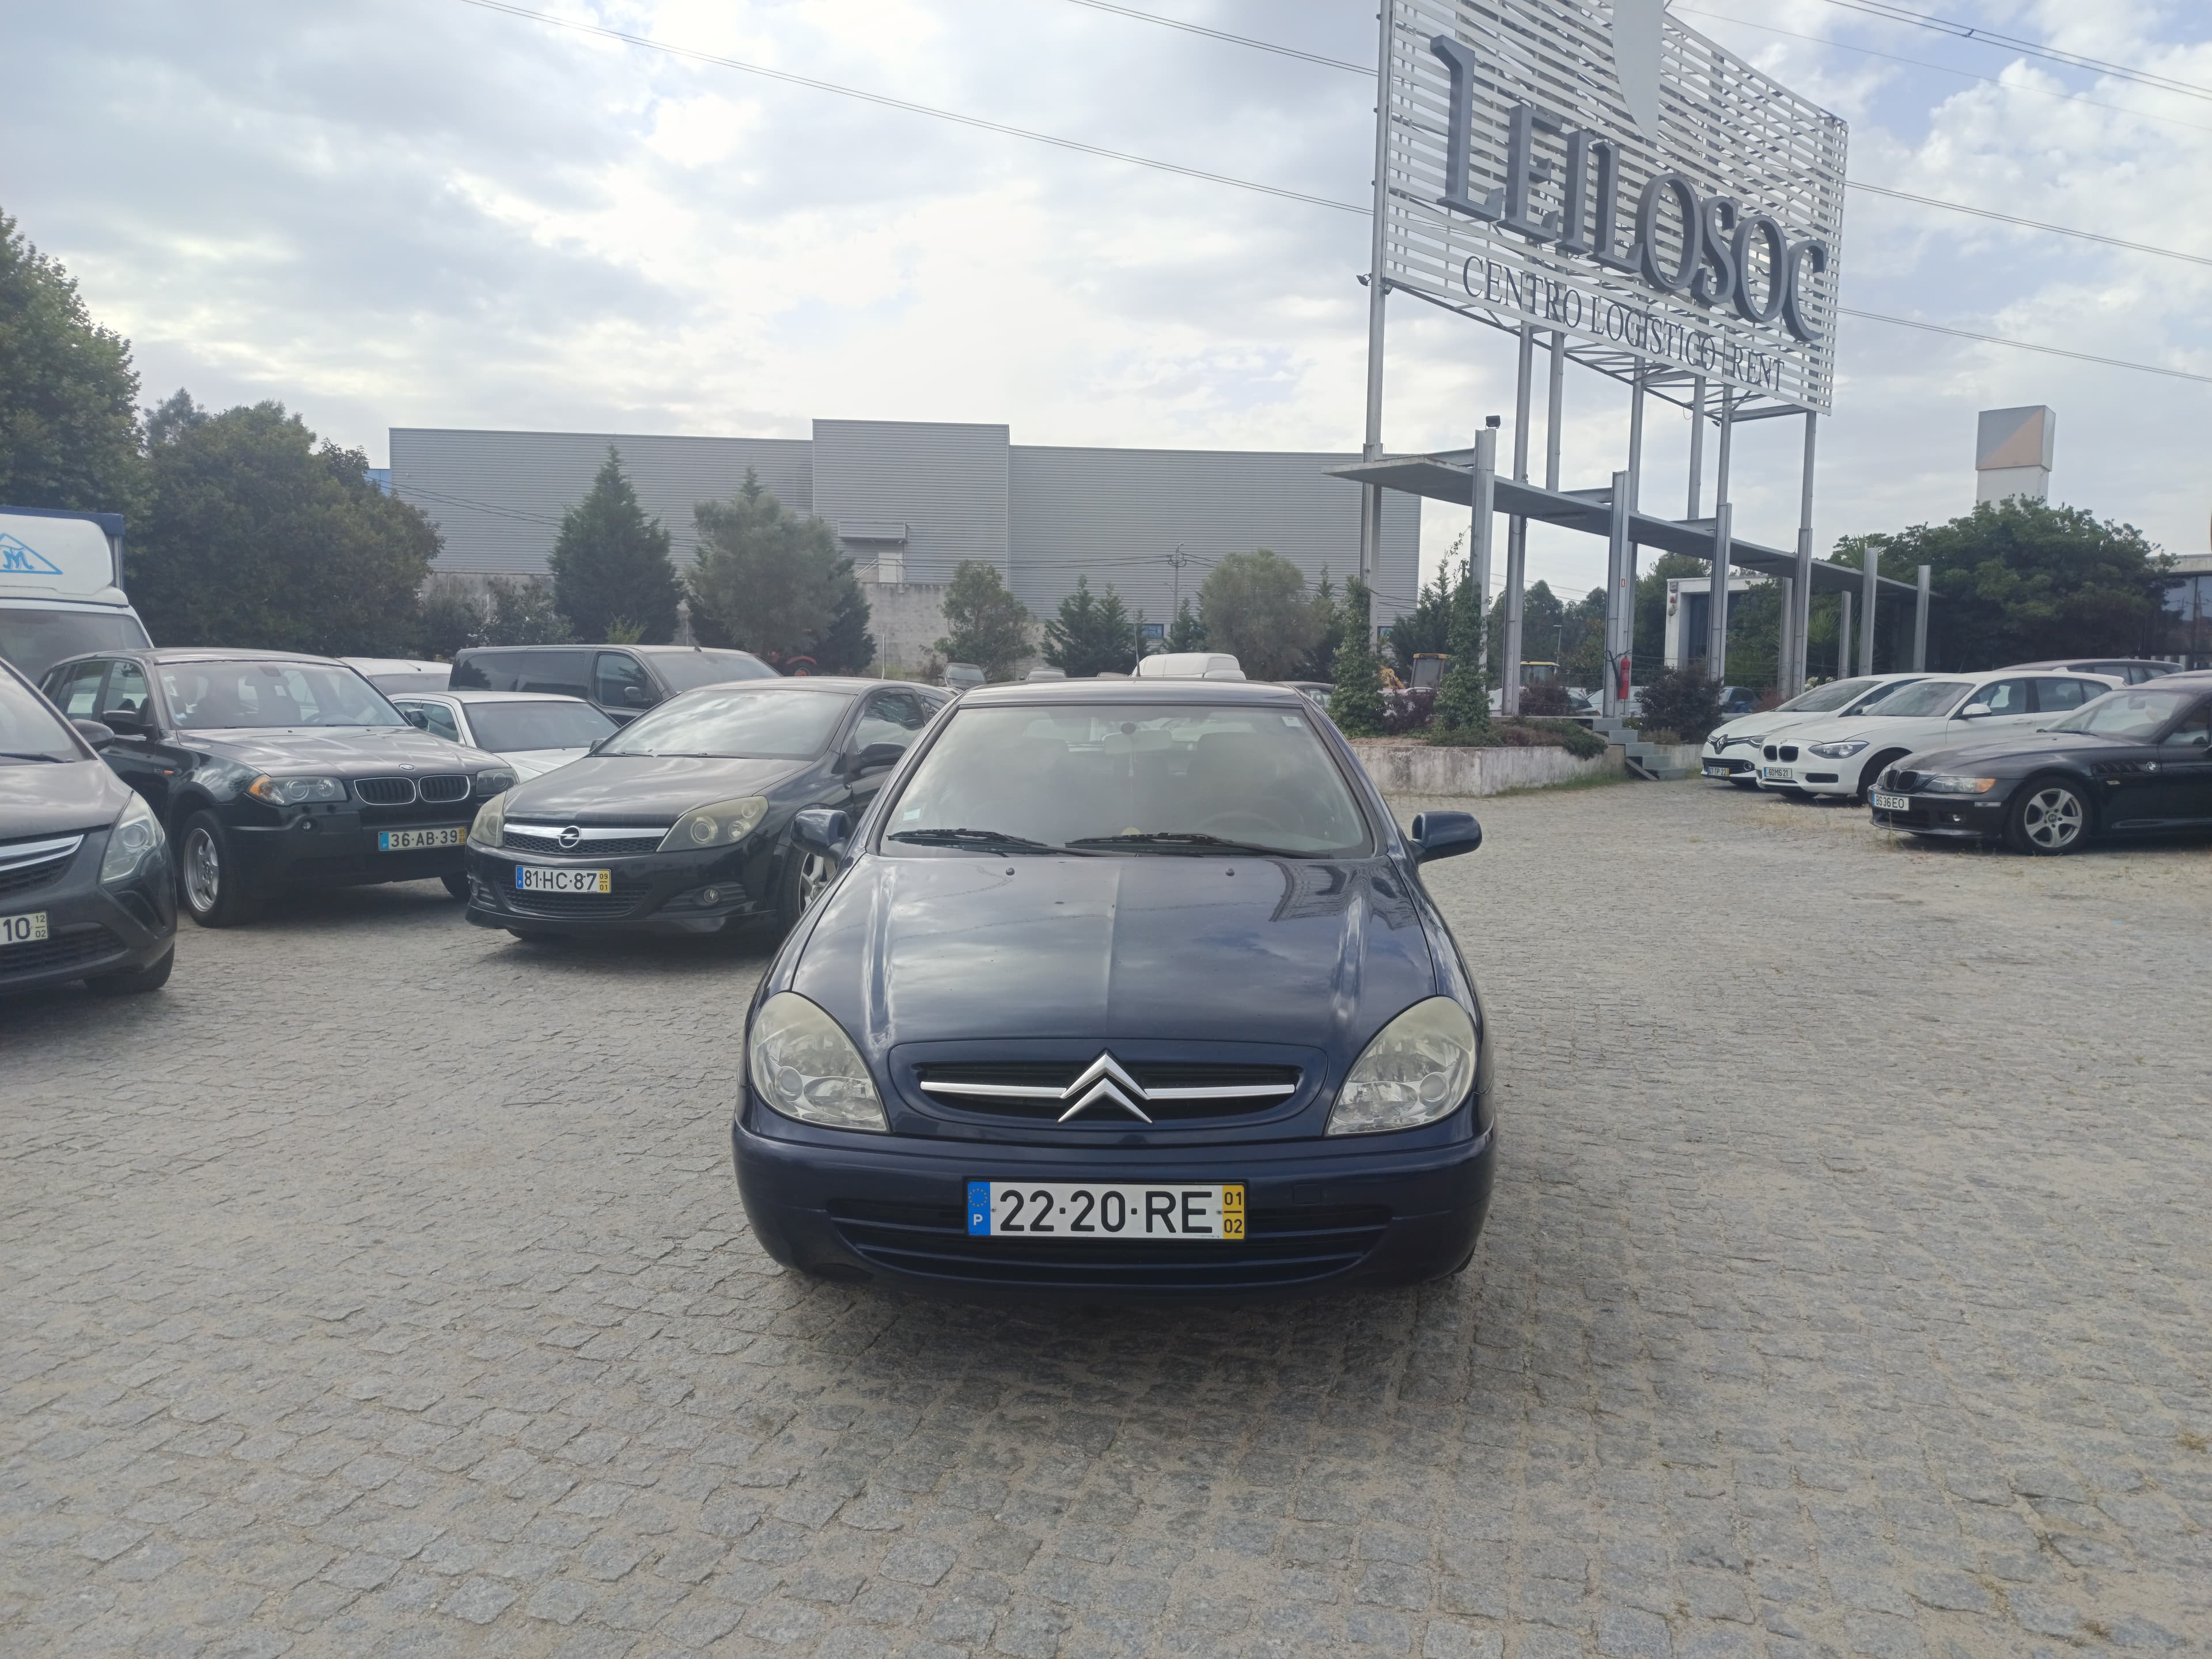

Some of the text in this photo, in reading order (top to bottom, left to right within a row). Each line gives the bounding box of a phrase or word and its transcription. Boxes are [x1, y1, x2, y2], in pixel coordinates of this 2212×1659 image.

[1430, 35, 1830, 341] LEILOSOC
[1463, 255, 1785, 392] CENTRO LOGÍSTICO RENT
[35, 915, 46, 923] 12
[35, 930, 47, 938] 02
[1224, 1192, 1242, 1206] 01
[973, 1214, 983, 1226] P
[1224, 1218, 1243, 1233] 02
